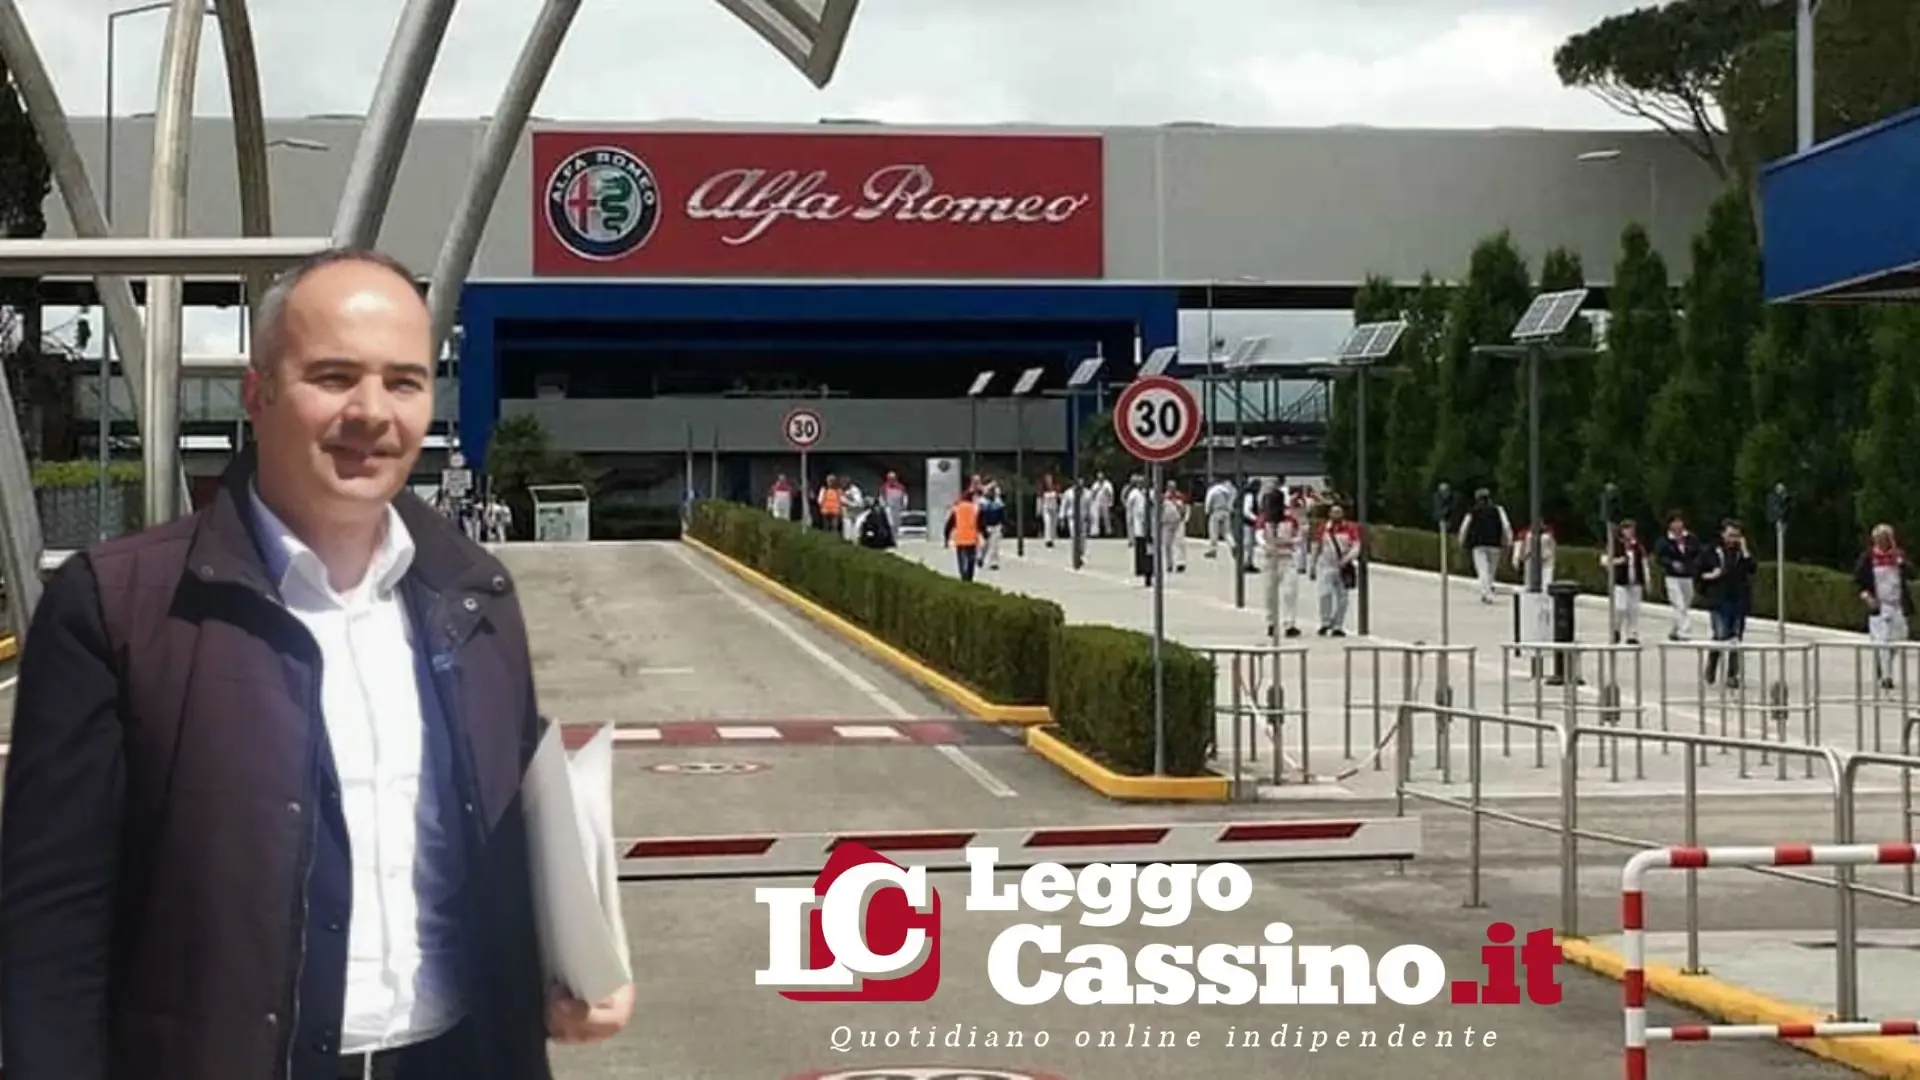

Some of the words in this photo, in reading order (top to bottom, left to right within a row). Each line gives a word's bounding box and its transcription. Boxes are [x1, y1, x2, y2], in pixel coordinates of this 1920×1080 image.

[686, 168, 855, 244] Alfa
[853, 164, 1088, 222] Romeo
[794, 420, 815, 438] 30
[1136, 400, 1181, 438] 30
